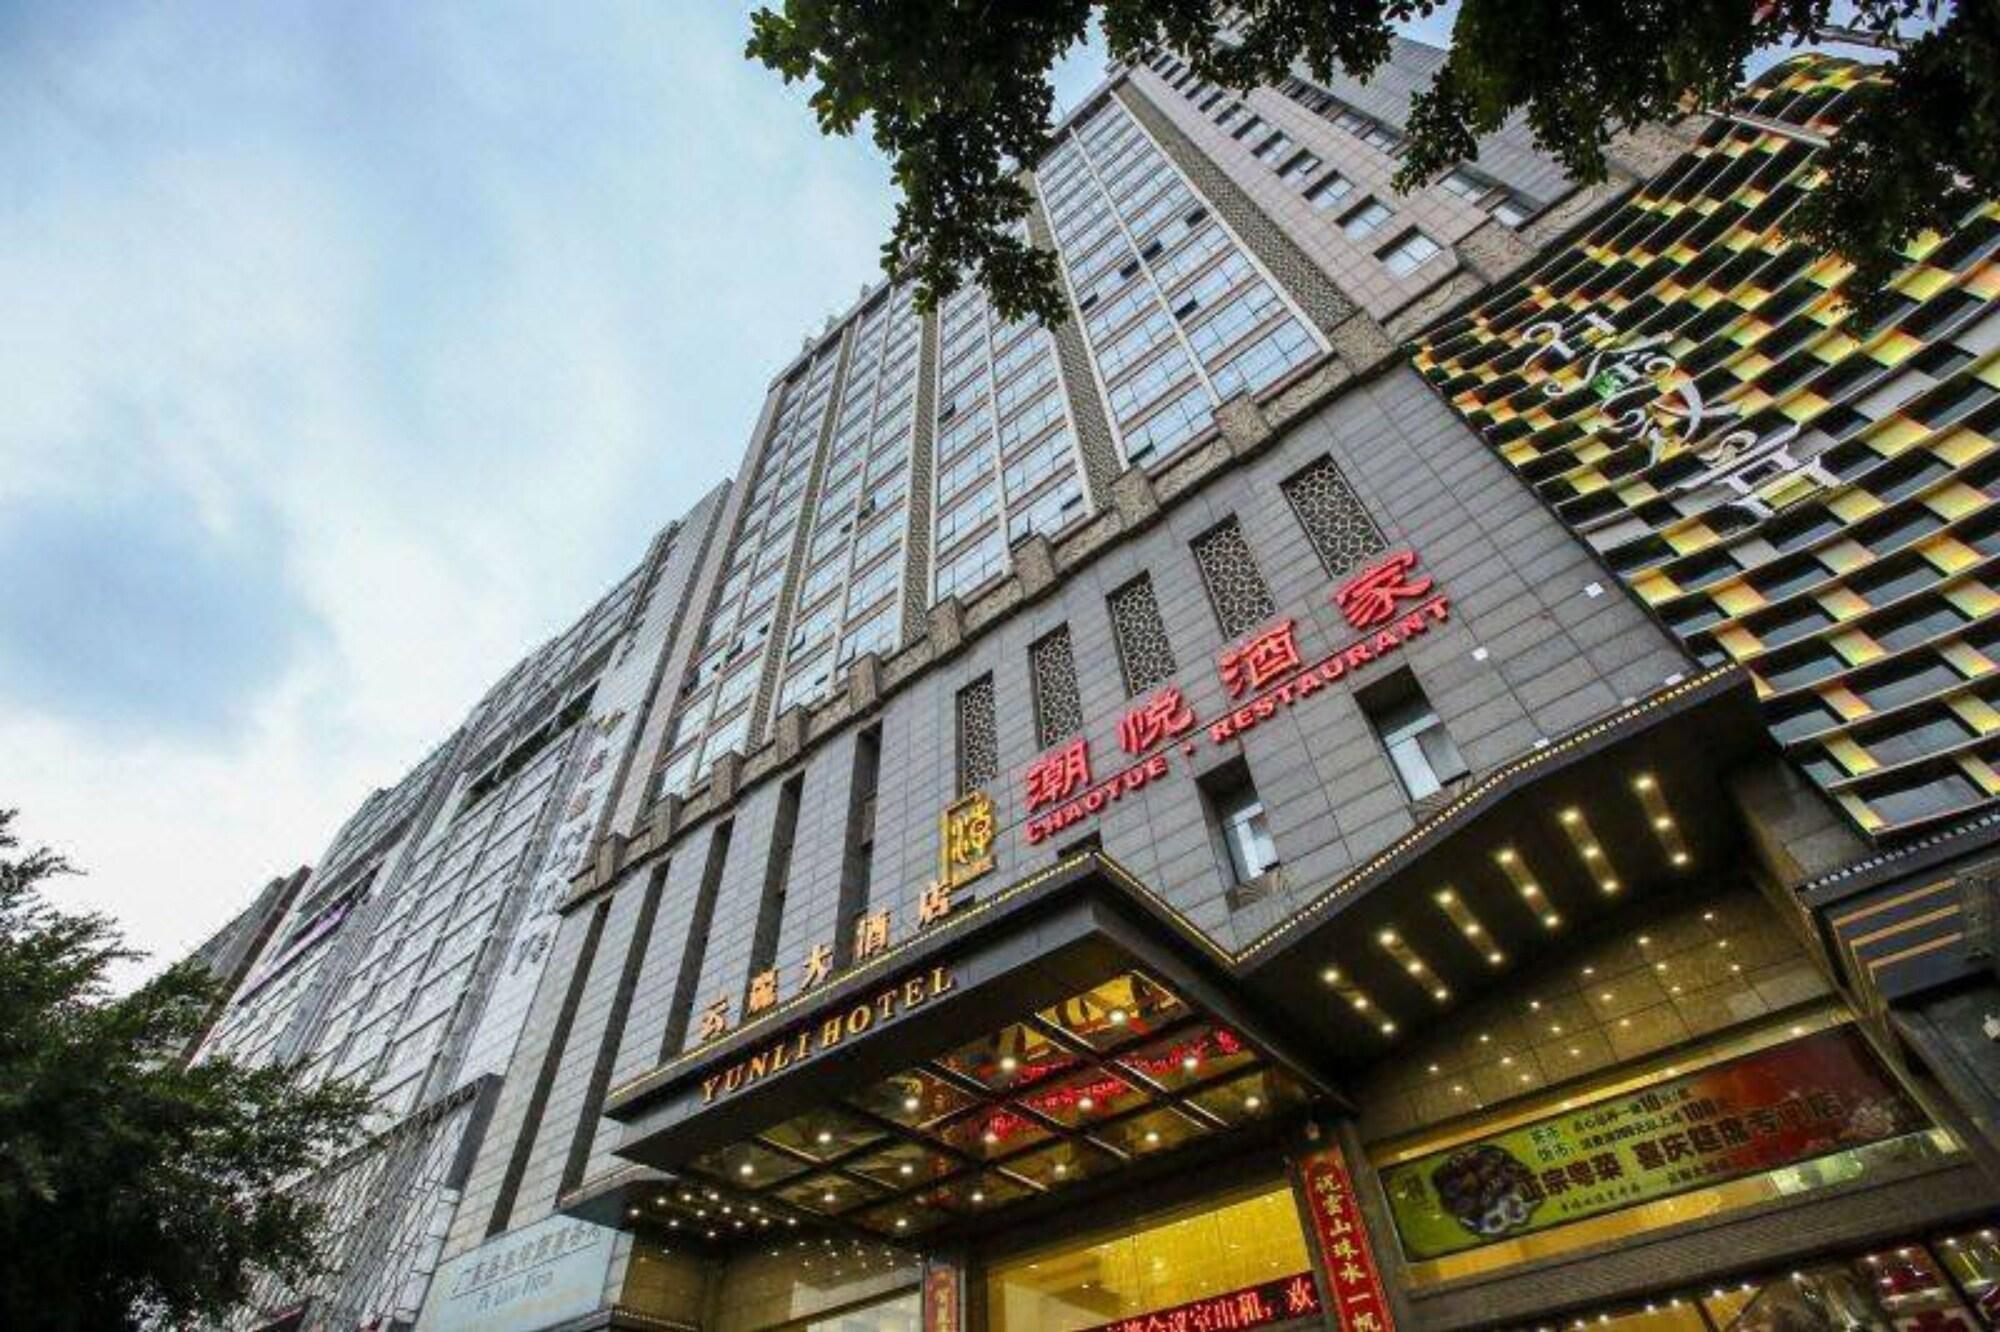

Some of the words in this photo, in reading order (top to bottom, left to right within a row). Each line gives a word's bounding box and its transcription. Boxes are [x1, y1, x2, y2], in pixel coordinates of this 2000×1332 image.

[1025, 753, 1168, 846] CHAOYUE
[1209, 596, 1449, 744] RESTAURANT
[701, 1032, 812, 1105] YUNLI
[821, 966, 954, 1048] HOTEL
